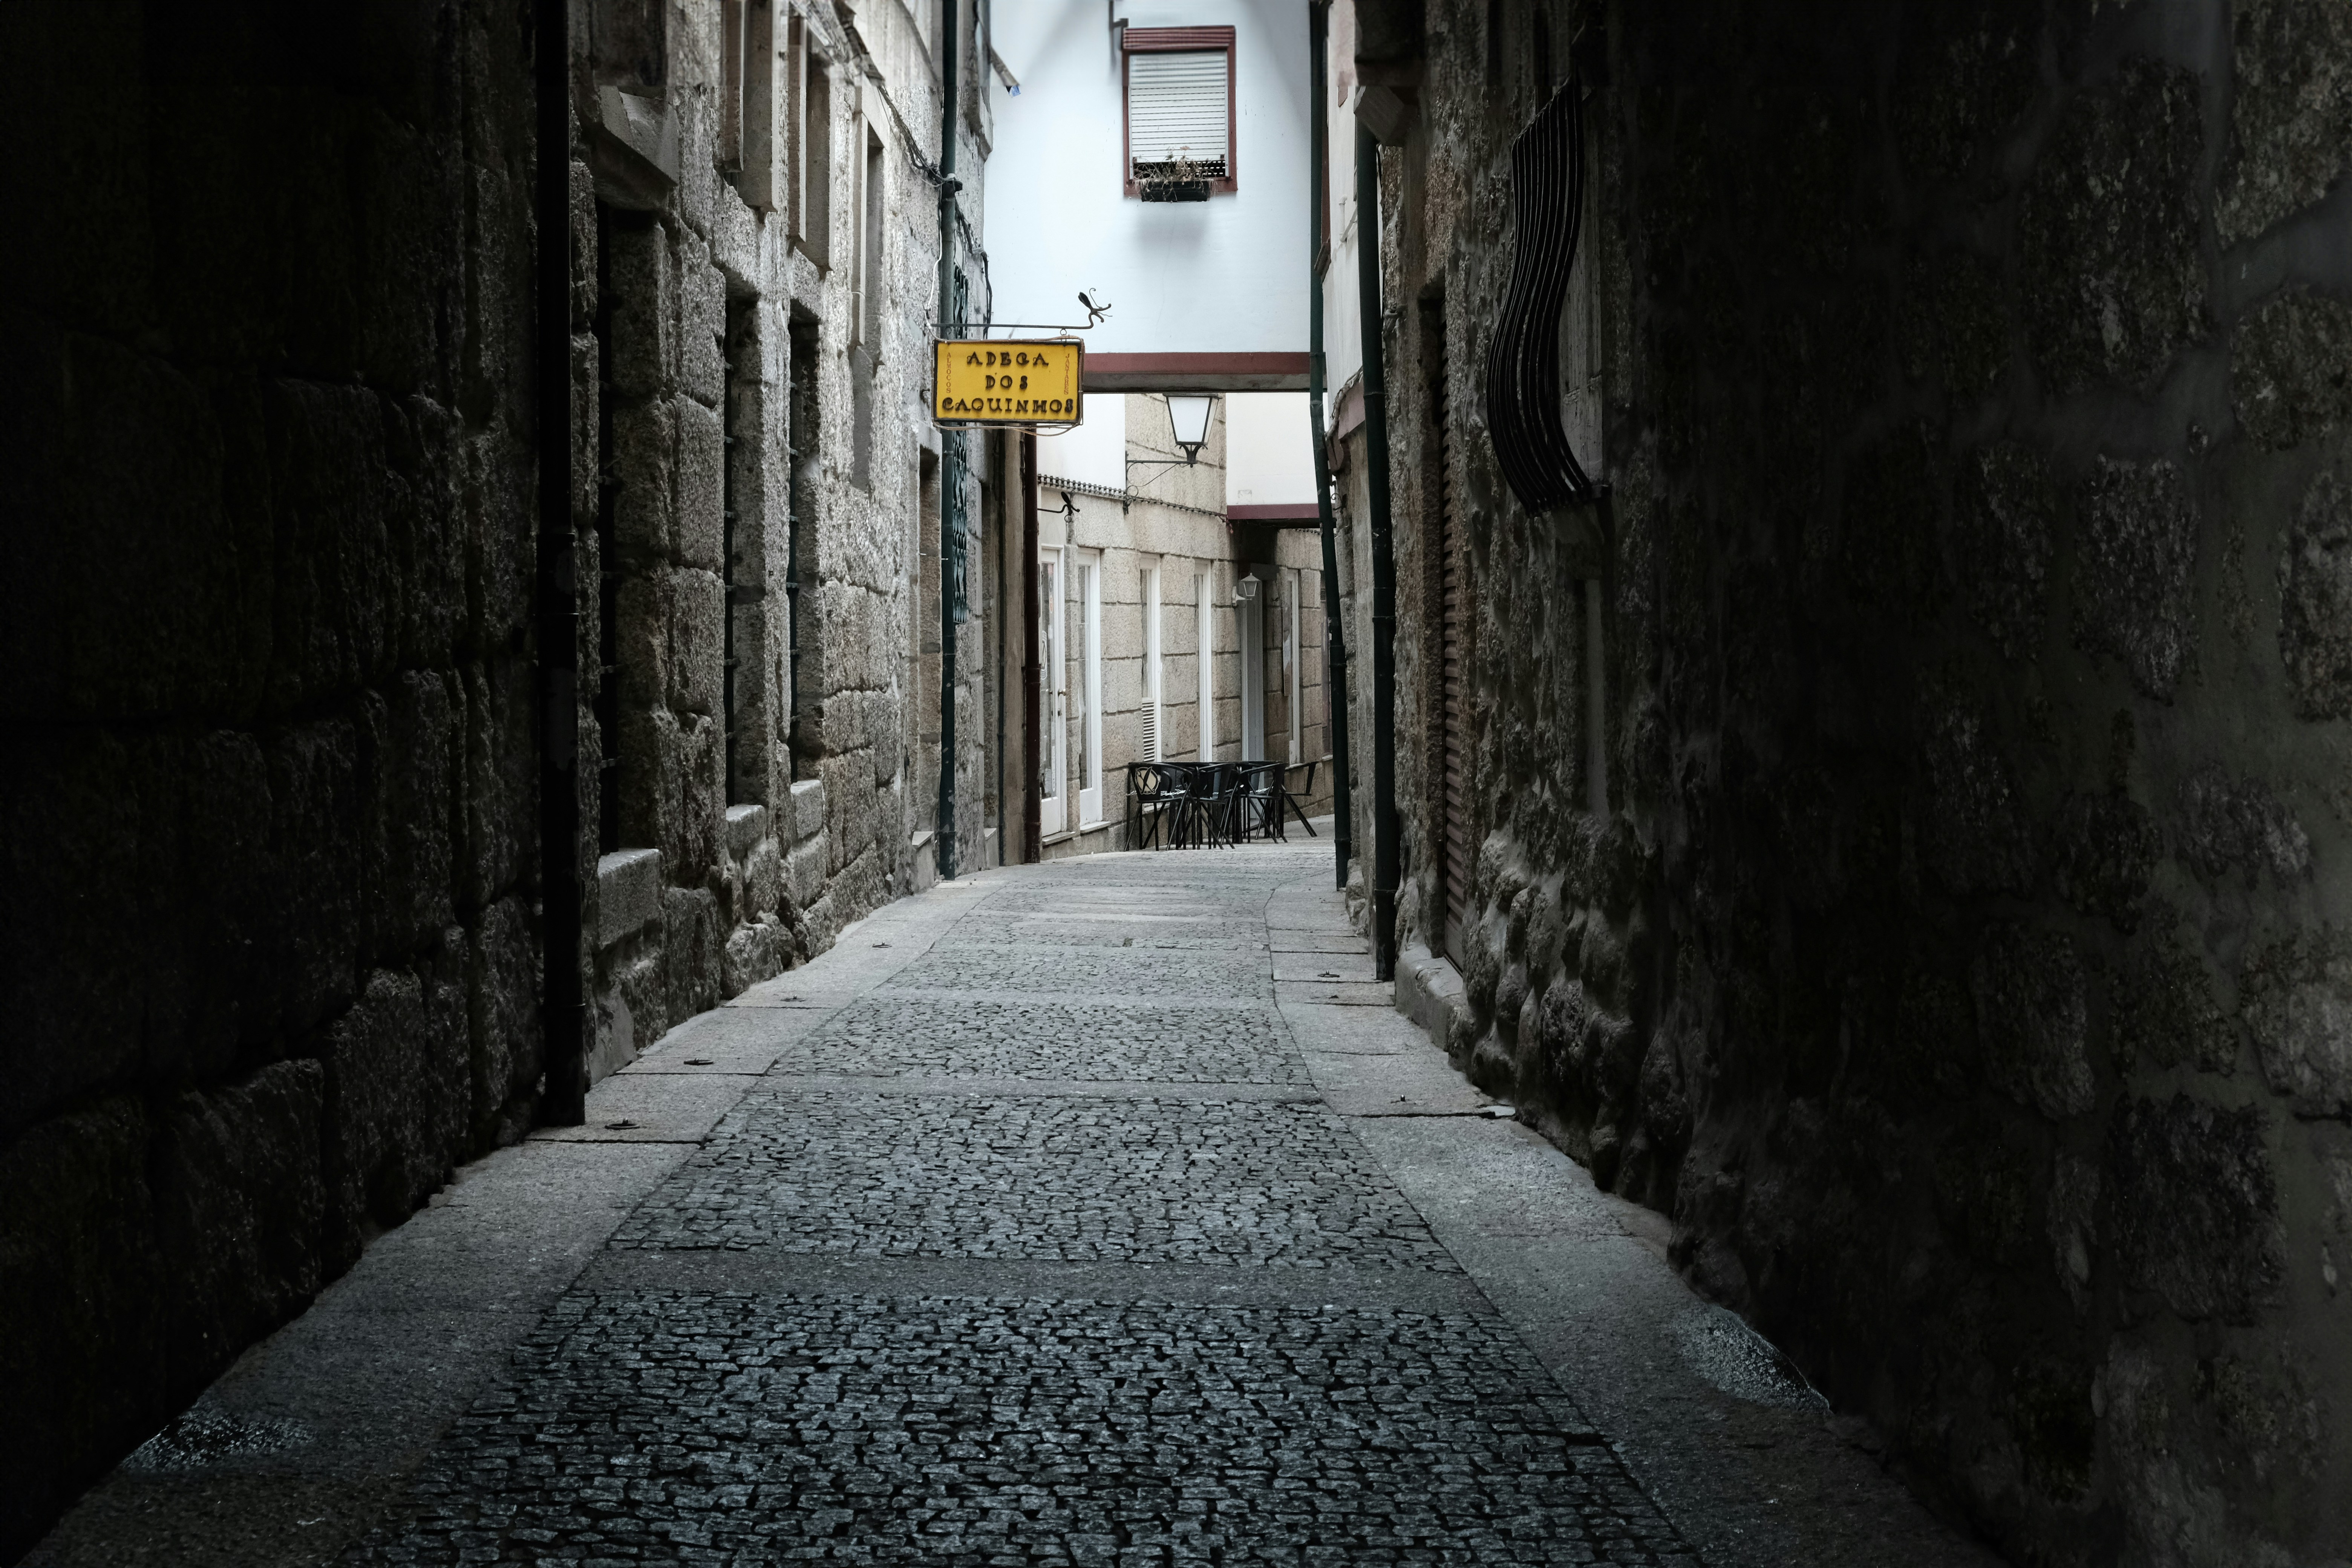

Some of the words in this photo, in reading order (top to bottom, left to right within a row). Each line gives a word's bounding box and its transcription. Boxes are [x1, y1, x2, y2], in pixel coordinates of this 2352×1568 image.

[966, 351, 1049, 366] ADEGA
[986, 375, 1028, 390] DOS
[942, 397, 1073, 413] CAQUINHOS
